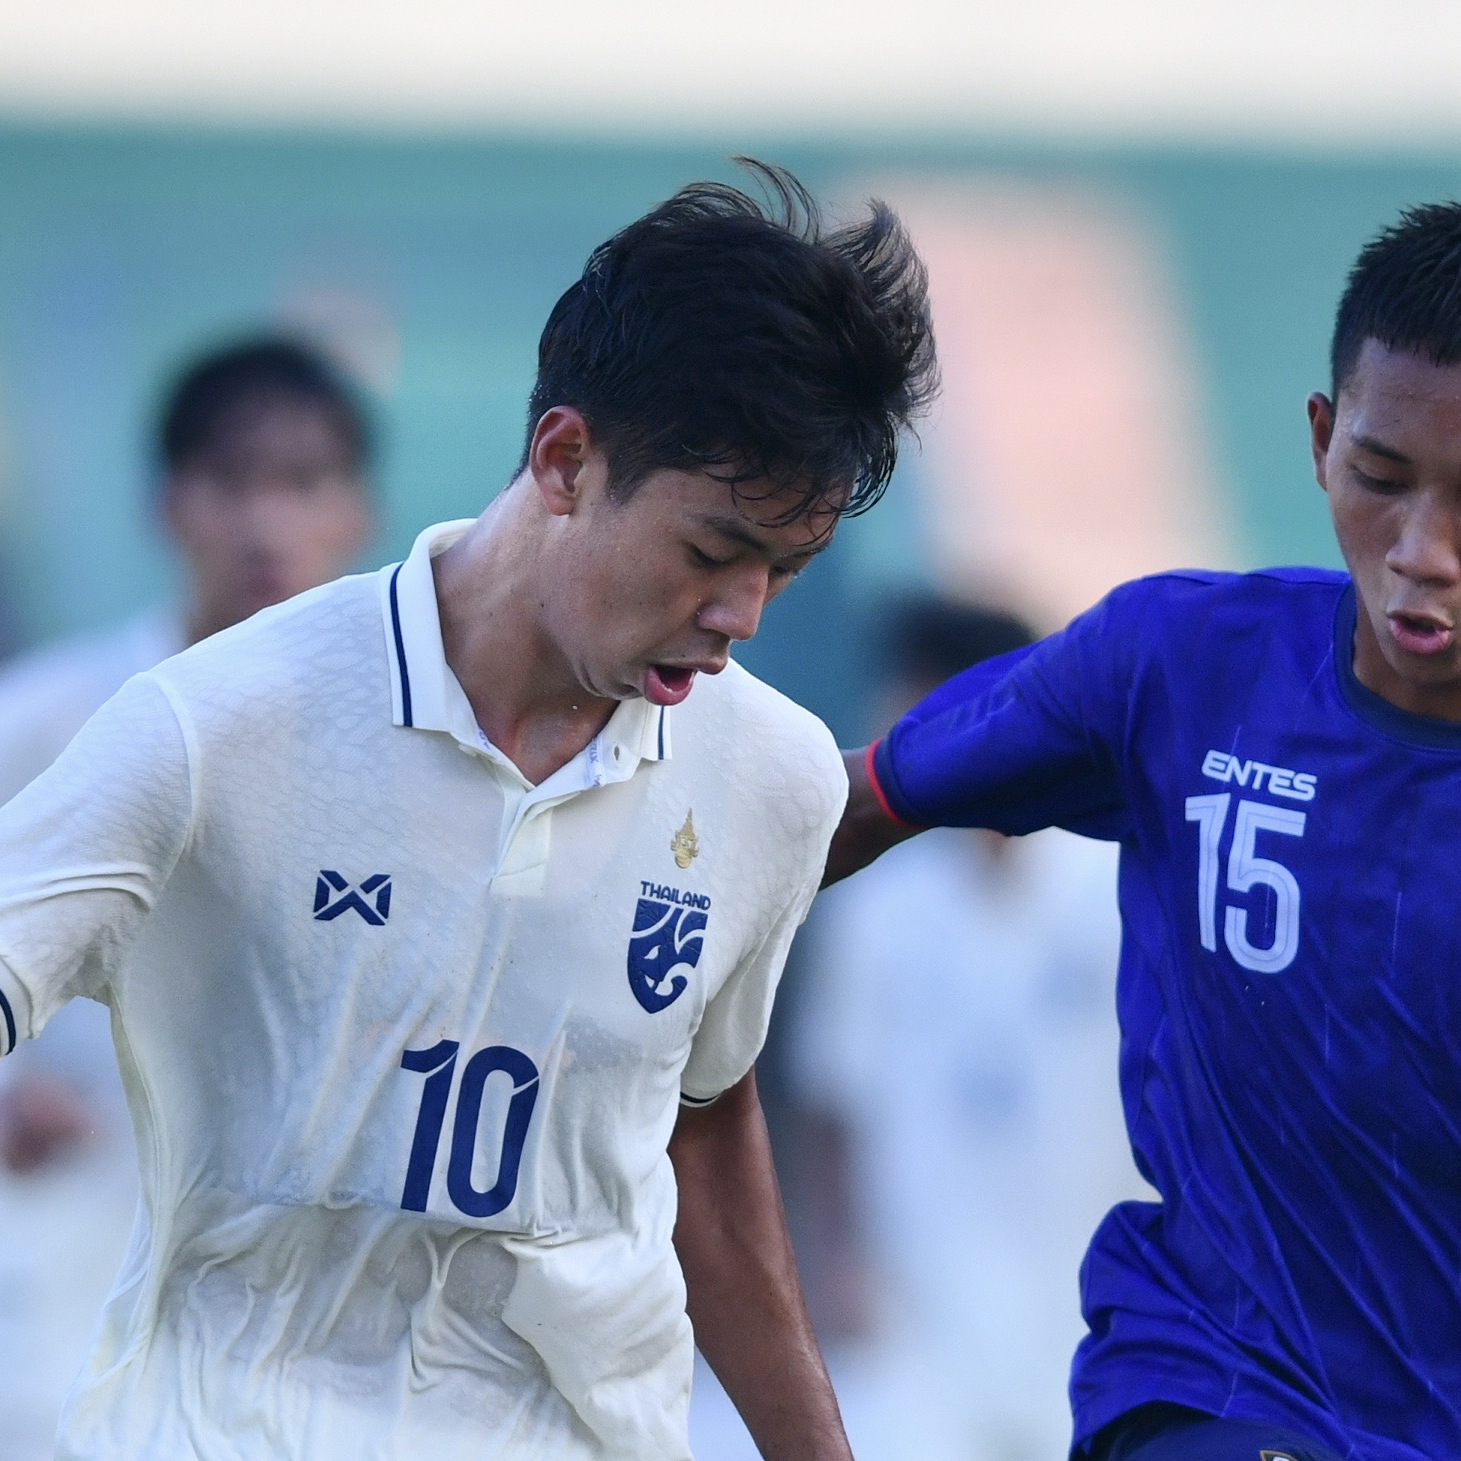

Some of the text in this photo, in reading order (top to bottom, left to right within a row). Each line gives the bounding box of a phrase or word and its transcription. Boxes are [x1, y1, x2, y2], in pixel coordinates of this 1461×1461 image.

[1201, 749, 1317, 801] ENTES
[640, 880, 712, 911] THAILAND
[1185, 792, 1306, 974] 15
[400, 1039, 539, 1218] 10
